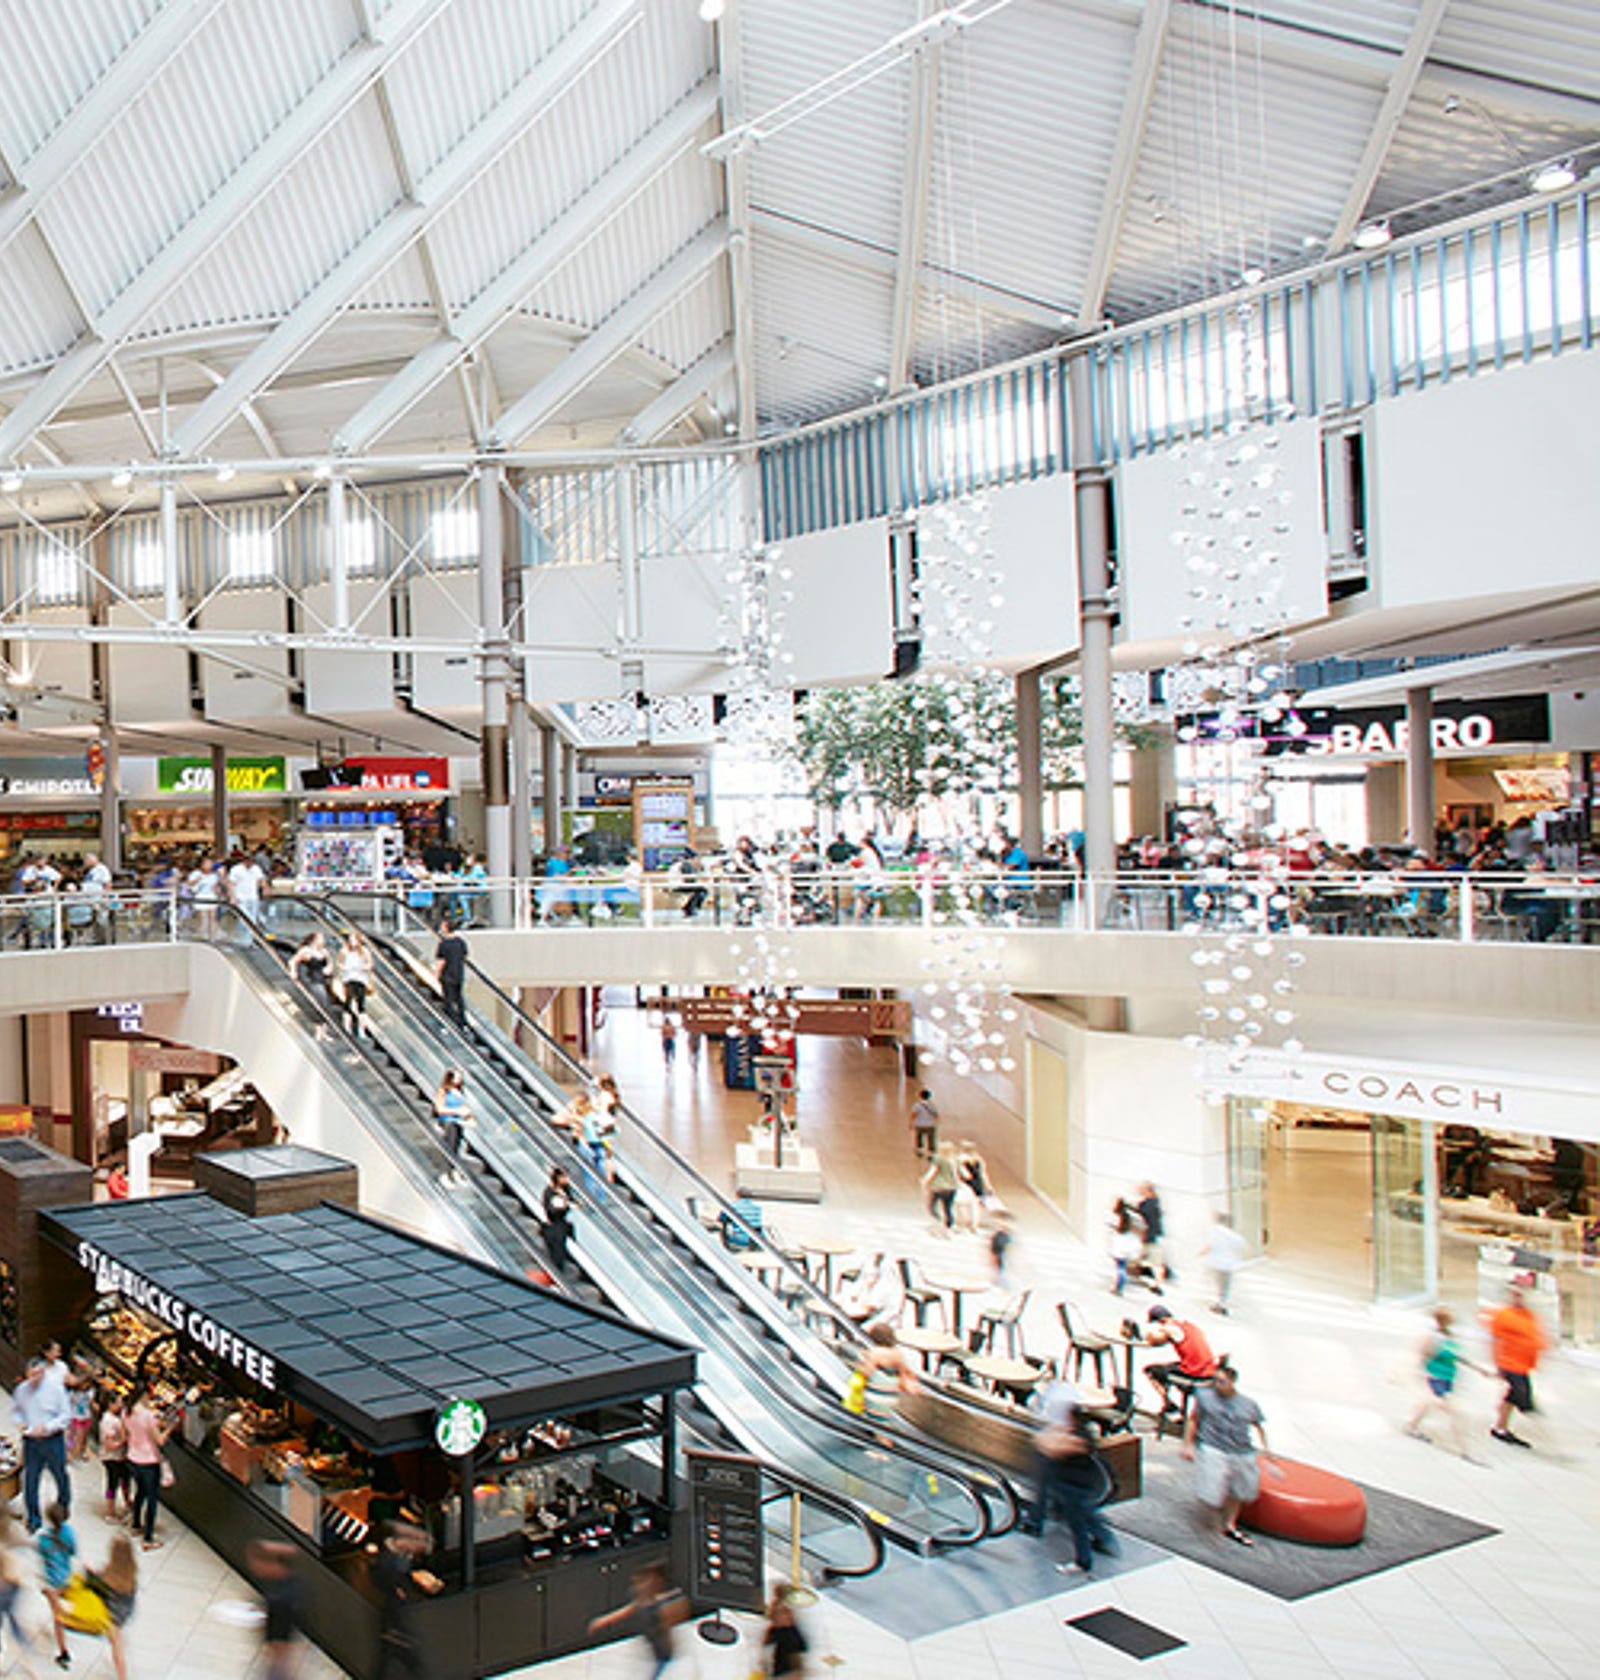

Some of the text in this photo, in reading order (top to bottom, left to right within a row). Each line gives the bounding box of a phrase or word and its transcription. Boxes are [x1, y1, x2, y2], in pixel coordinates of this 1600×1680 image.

[1322, 1071, 1504, 1113] COACH
[78, 1241, 278, 1392] STARBUCKS COFFEE
